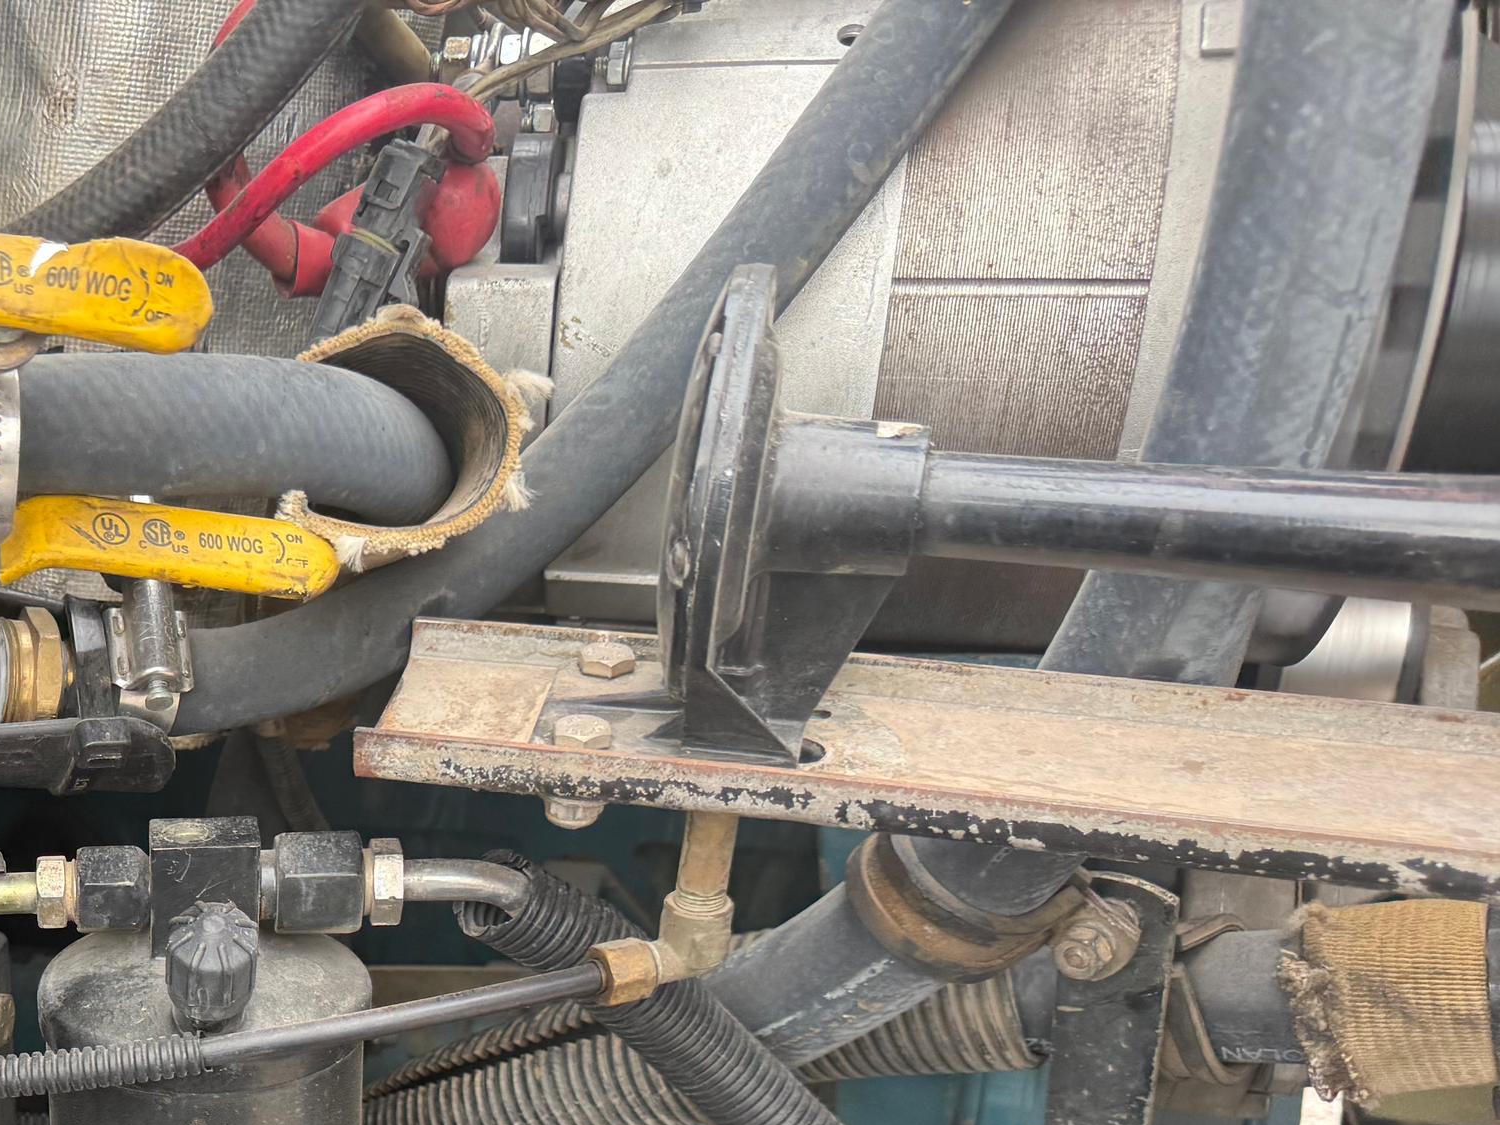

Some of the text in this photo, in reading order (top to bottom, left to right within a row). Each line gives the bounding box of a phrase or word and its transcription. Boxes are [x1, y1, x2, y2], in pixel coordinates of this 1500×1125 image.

[46, 266, 131, 302] 600 WOG
[198, 532, 263, 554] 600 WOG
[286, 534, 303, 544] ON
[172, 544, 189, 554] US
